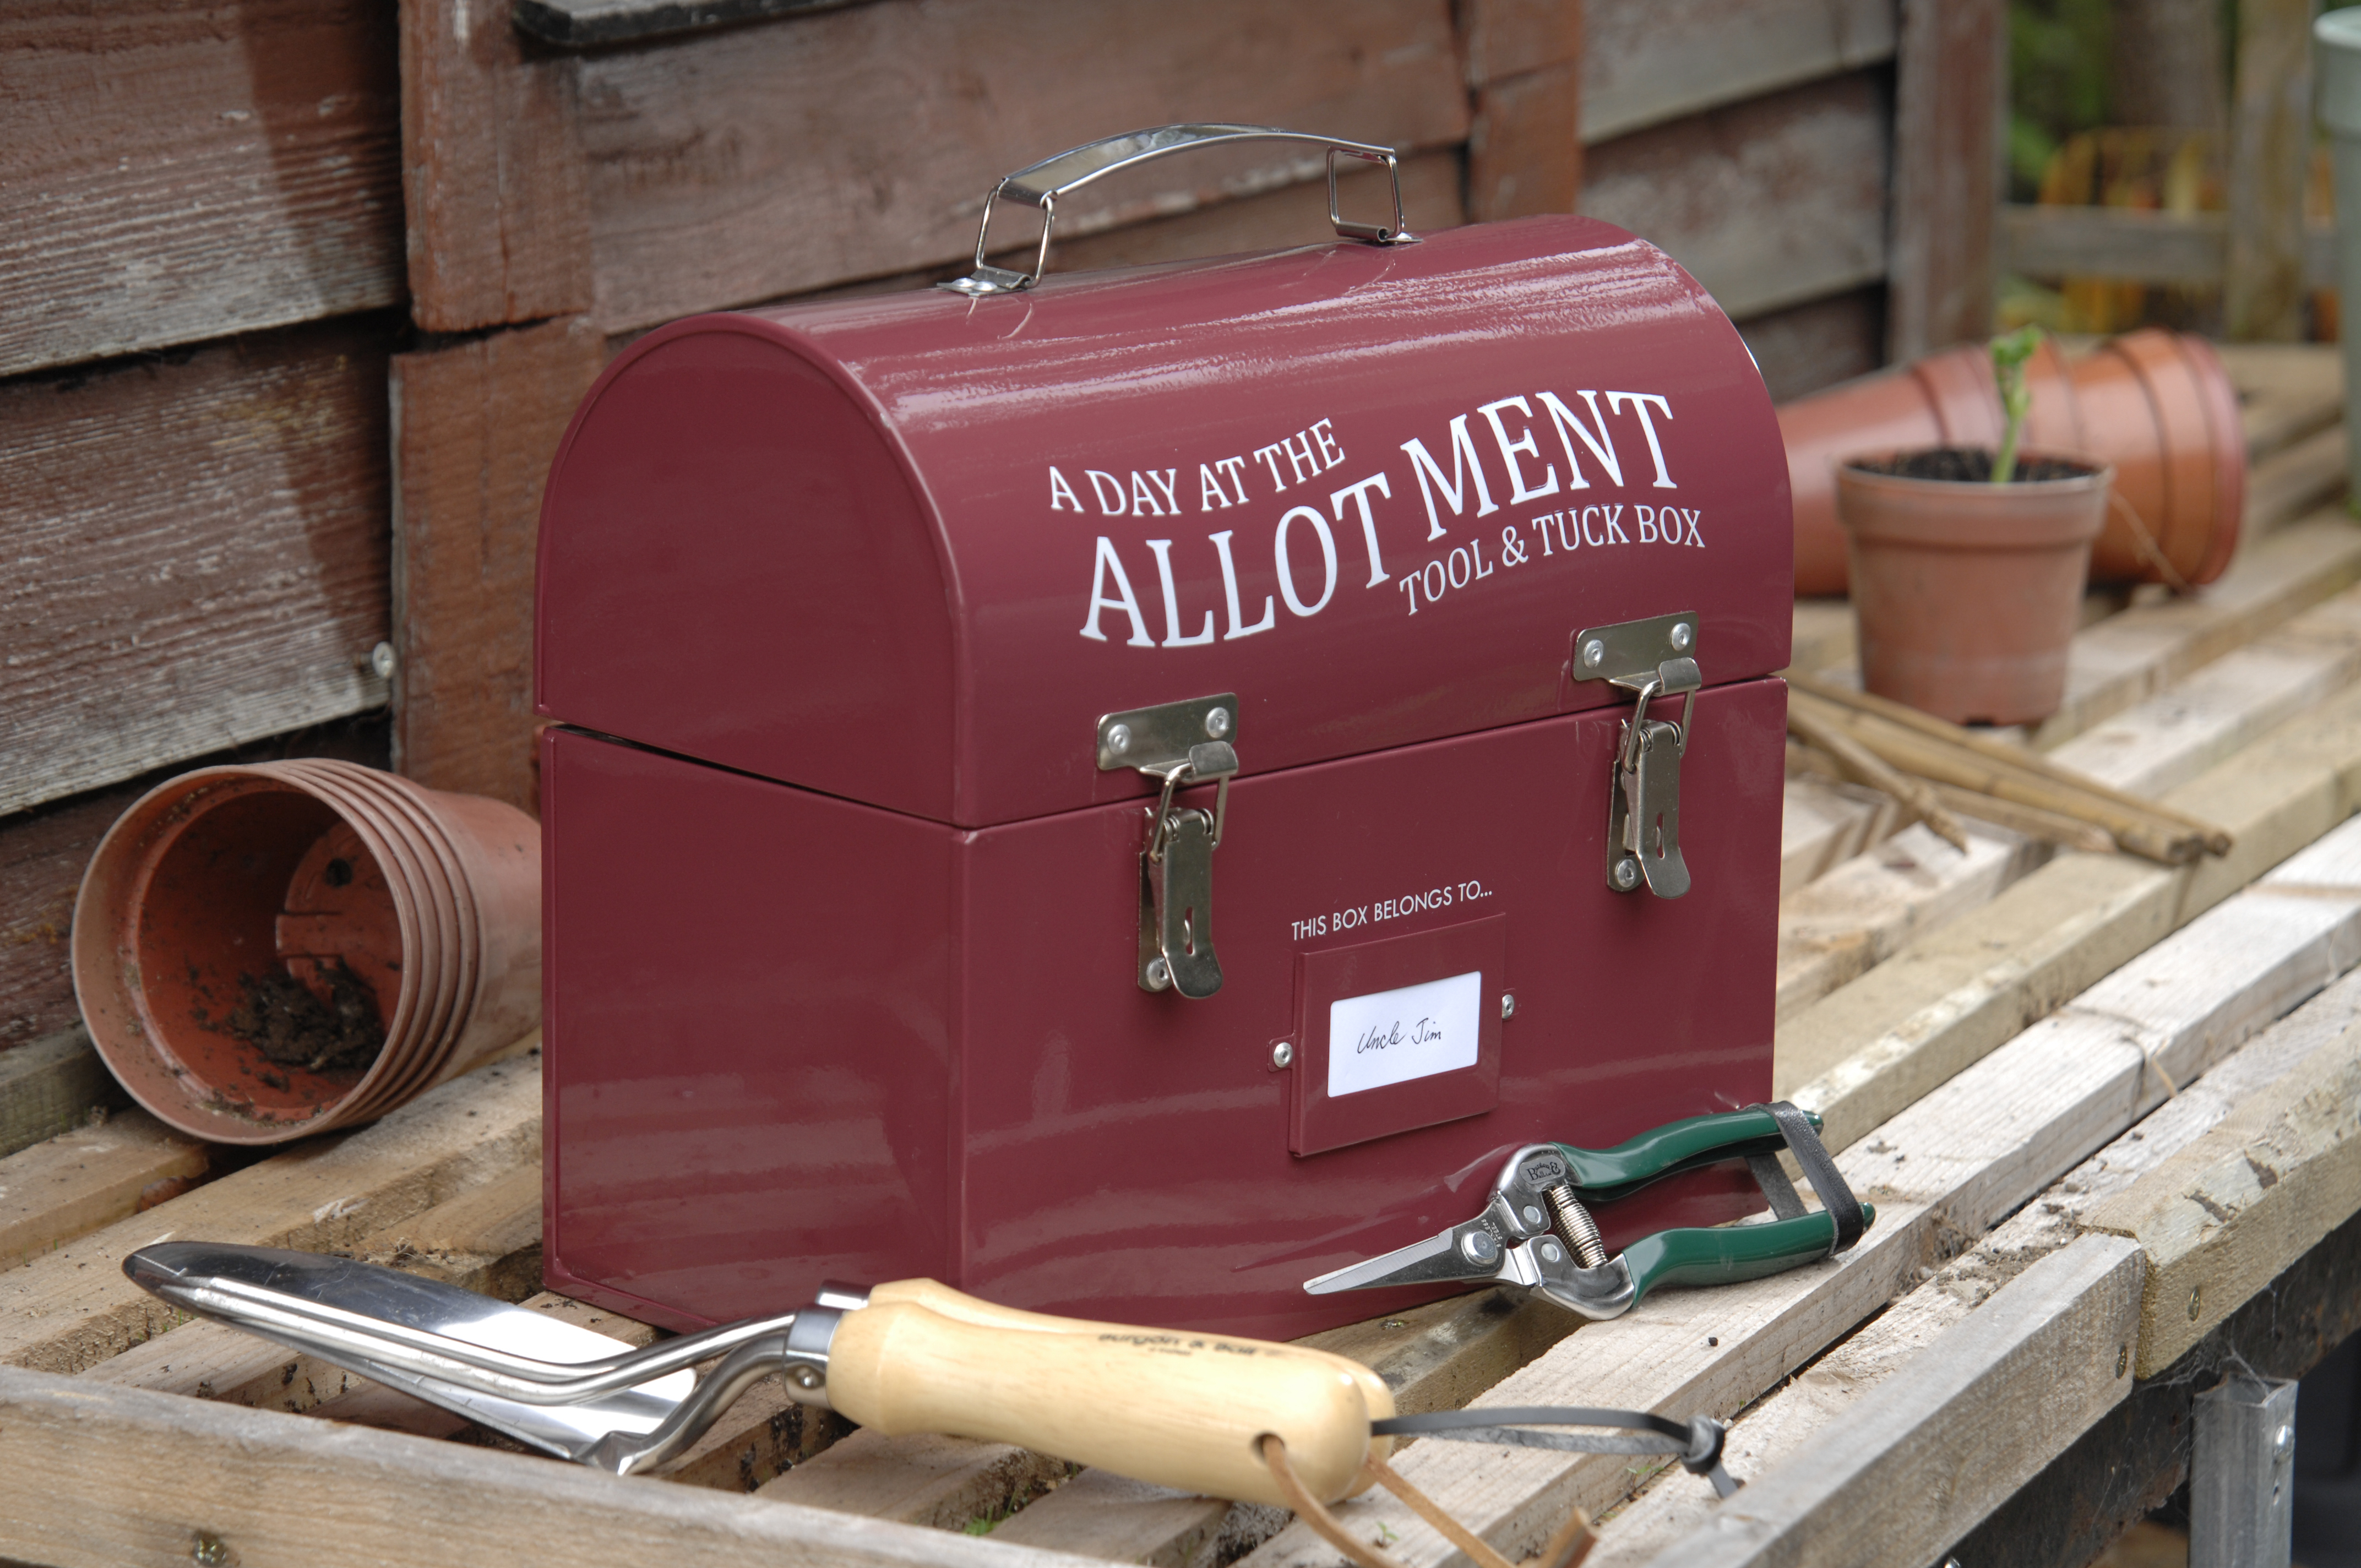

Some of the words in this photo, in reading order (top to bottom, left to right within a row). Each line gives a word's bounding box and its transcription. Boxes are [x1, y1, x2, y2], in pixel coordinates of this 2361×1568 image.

[1048, 465, 1085, 514] A
[1084, 467, 1182, 516] DAY
[1199, 455, 1250, 512] AT
[1252, 417, 1346, 493] THE
[1399, 538, 1494, 616] TOOL
[1502, 525, 1529, 568] &
[1531, 504, 1630, 557] TUCK
[1633, 504, 1706, 548] BOX
[1291, 915, 1327, 941] THIS
[1332, 905, 1368, 932] BOX
[1374, 885, 1452, 922] BELONGS
[1357, 1021, 1407, 1054] Uncle
[1411, 1017, 1441, 1044] Jim
